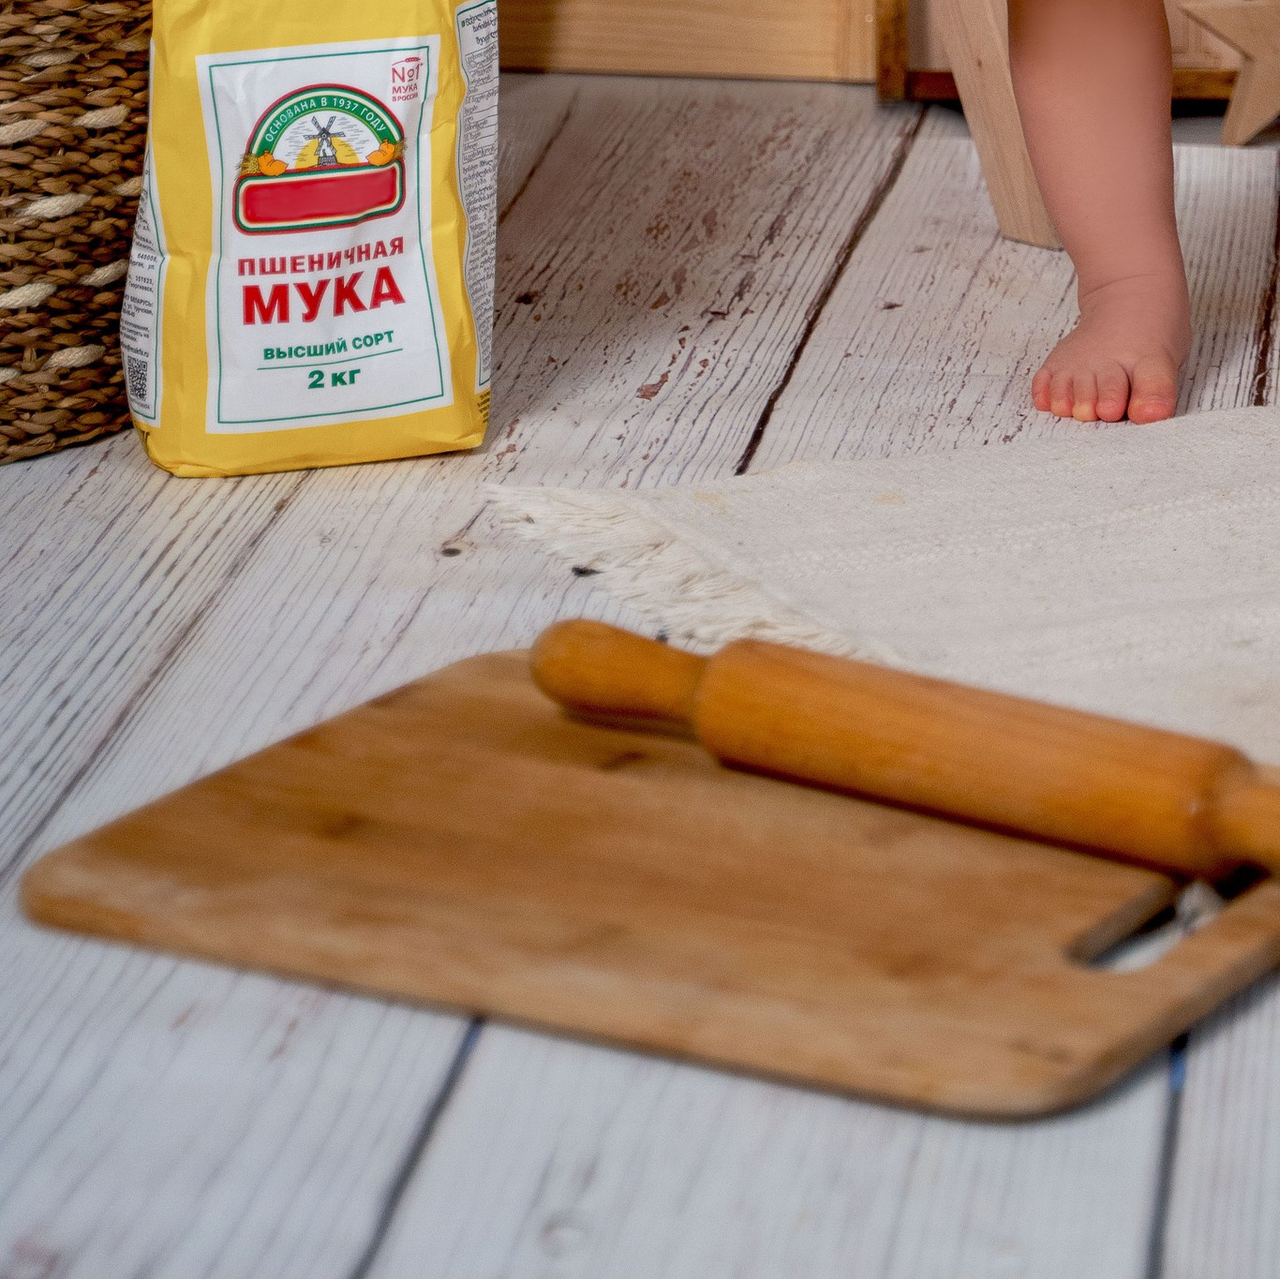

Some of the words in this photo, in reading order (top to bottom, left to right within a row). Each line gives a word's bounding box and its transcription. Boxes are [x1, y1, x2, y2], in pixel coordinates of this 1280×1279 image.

[392, 83, 418, 94] МУКА
[265, 98, 317, 142] ОСНОВАНА
[321, 97, 327, 107] В
[333, 97, 358, 112] 1937
[359, 107, 387, 131] ГОДУ
[237, 236, 404, 276] ПШЕНИЧНАЯ
[242, 266, 406, 325] МУКА
[263, 337, 348, 360] ВЫСШИЙ
[352, 330, 395, 349] СОРТ
[308, 370, 325, 390] 2
